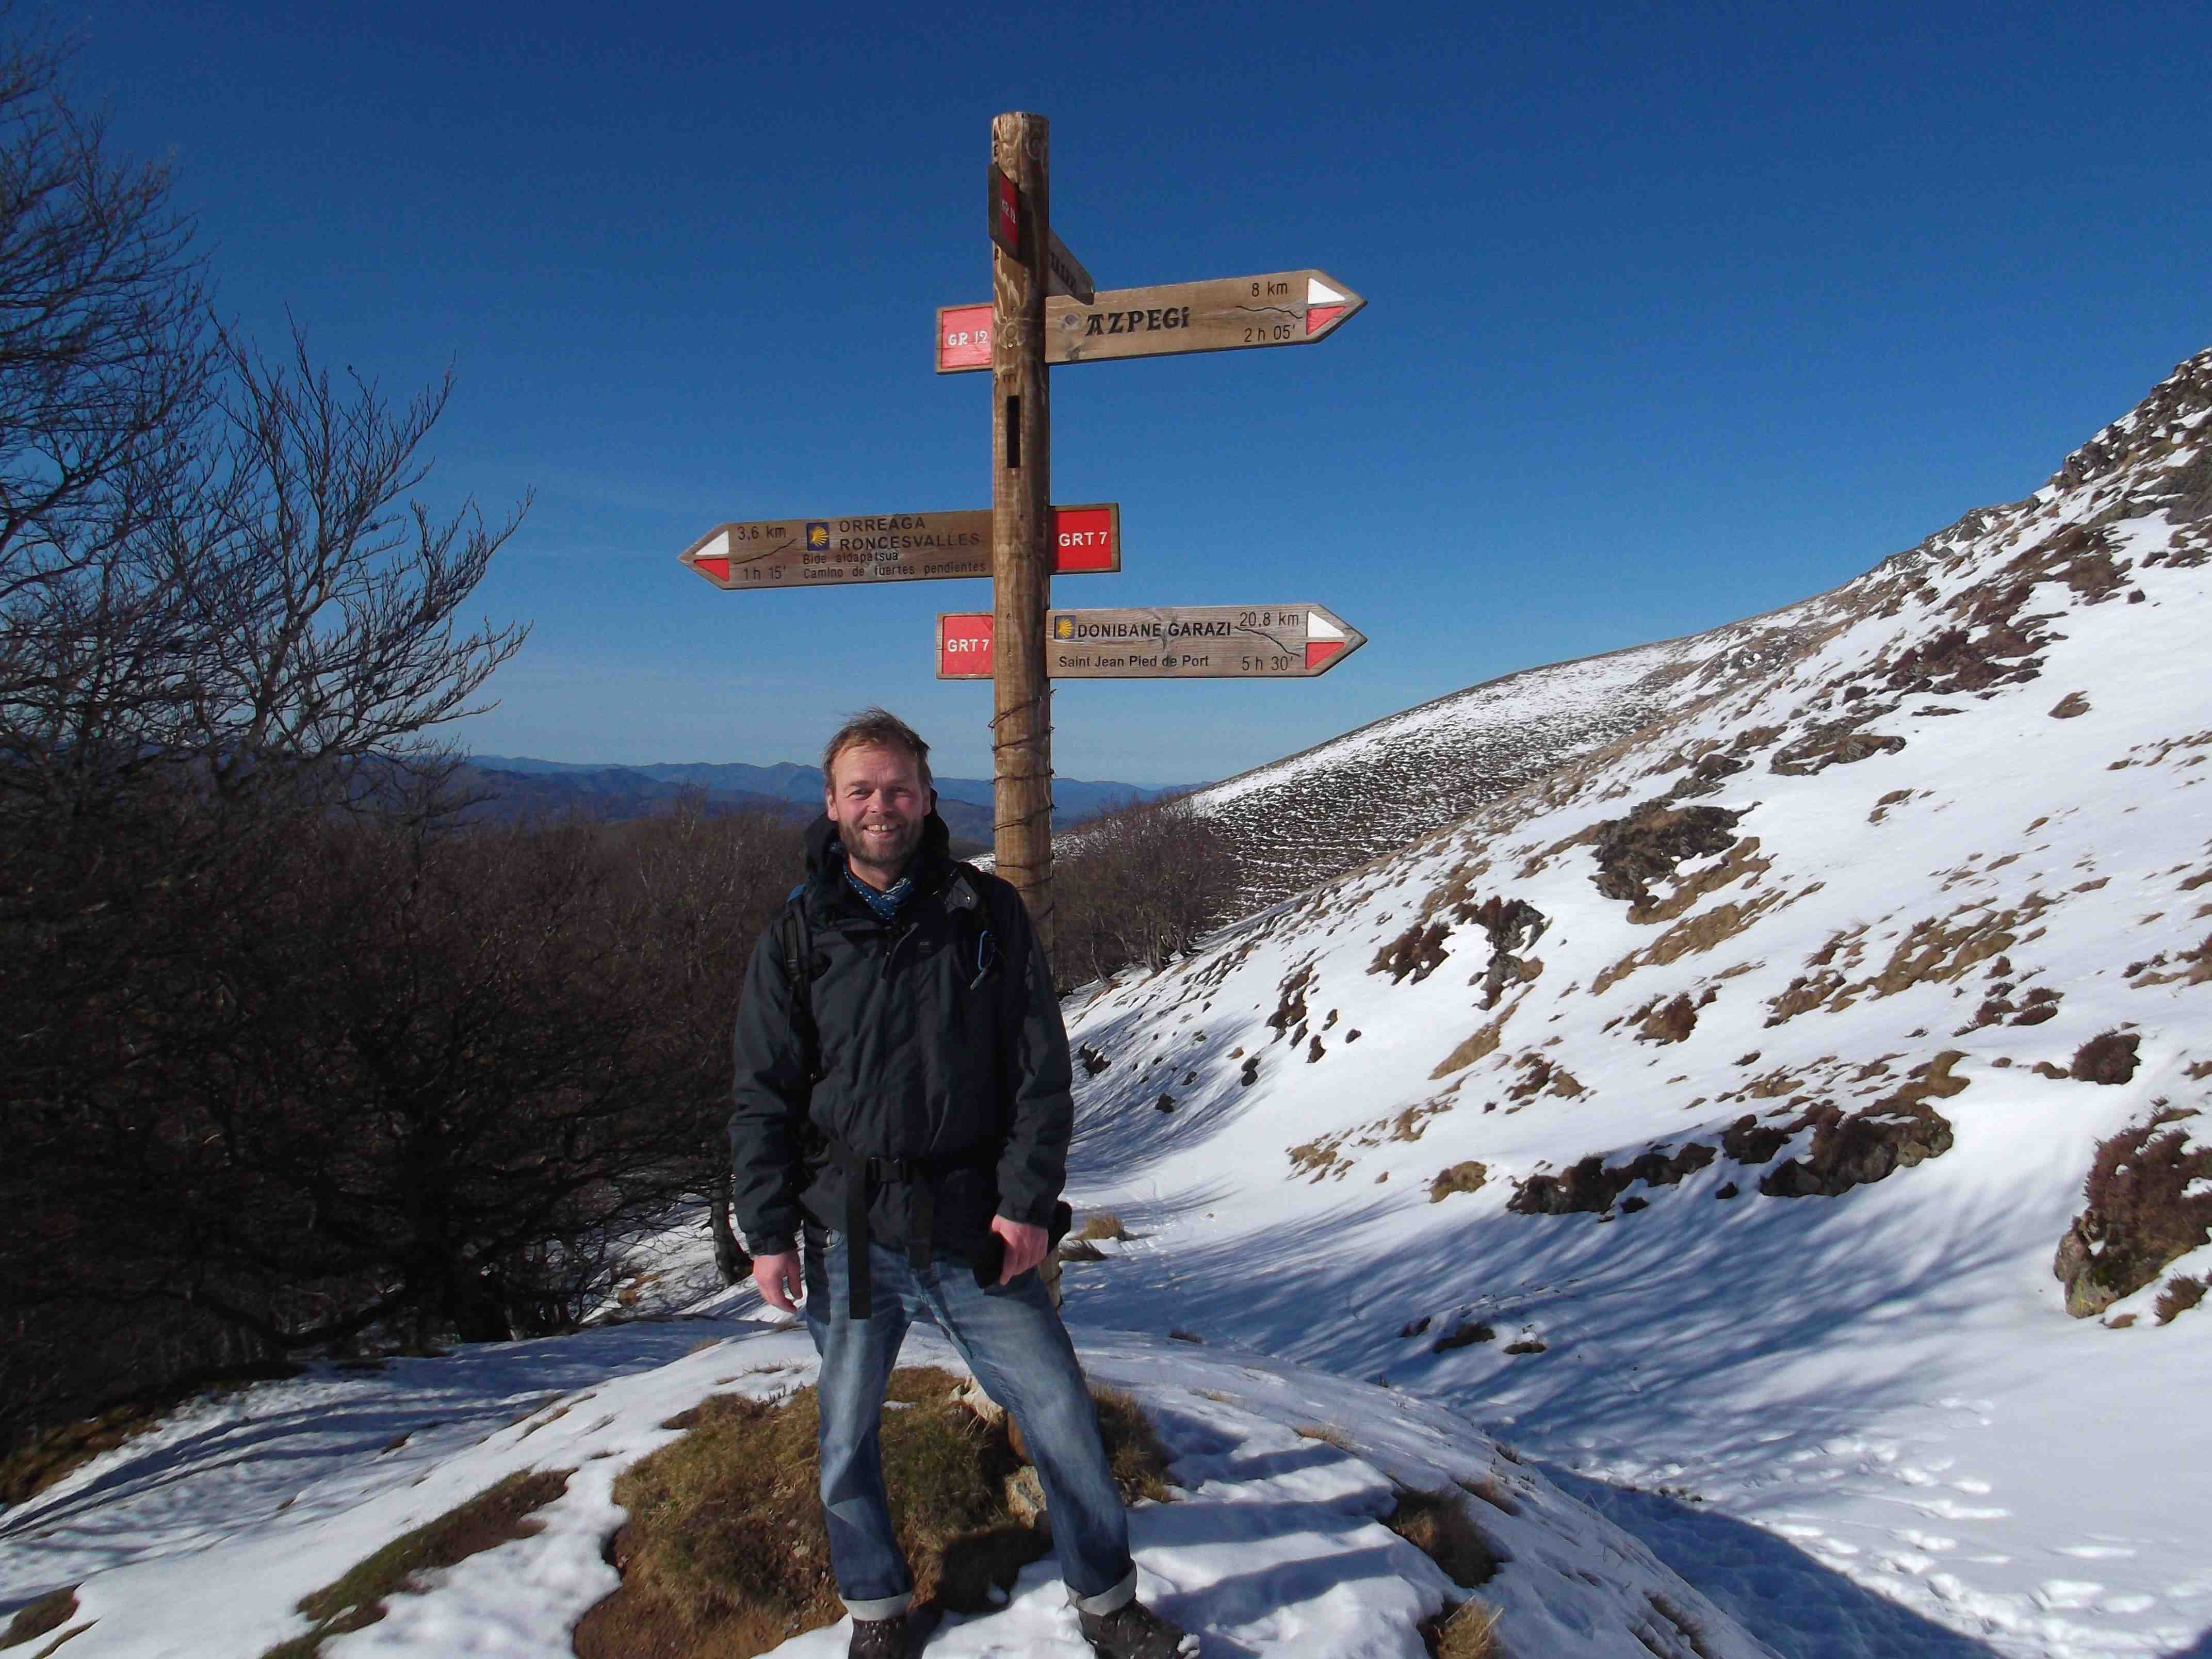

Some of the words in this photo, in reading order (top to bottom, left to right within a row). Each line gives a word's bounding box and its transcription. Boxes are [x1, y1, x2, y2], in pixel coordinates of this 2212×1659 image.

[1251, 283, 1259, 297] 8
[1267, 281, 1288, 296] km
[948, 332, 968, 346] GR
[1244, 328, 1252, 342] 2
[1258, 327, 1265, 341] h
[1274, 324, 1295, 340] 05'
[839, 517, 925, 532] ORREAGA
[766, 526, 786, 539] km
[1059, 532, 1094, 547] GRT
[1098, 531, 1107, 545] 7
[840, 533, 980, 550] RONCESVALLES
[803, 554, 826, 565] Bide
[836, 552, 898, 565] aldapatsua
[743, 568, 748, 580] 1
[754, 567, 760, 580] h
[768, 565, 787, 579] 15'
[804, 567, 843, 578] Camino
[852, 566, 865, 577] de
[874, 565, 915, 576] fuertes
[924, 562, 985, 576] pendientes
[1278, 612, 1299, 626] km
[1078, 623, 1161, 638] DONIBANE
[1168, 622, 1231, 637] GARAZI
[948, 639, 979, 652] GRT
[982, 639, 989, 652] 7
[1059, 656, 1091, 667] Saint
[1095, 656, 1124, 667] Jean
[1129, 655, 1157, 666] Pied
[1162, 655, 1177, 666] de
[1182, 655, 1209, 666] Port
[1242, 656, 1250, 671] 5
[1256, 657, 1263, 671] h
[1271, 656, 1293, 671] 30'
